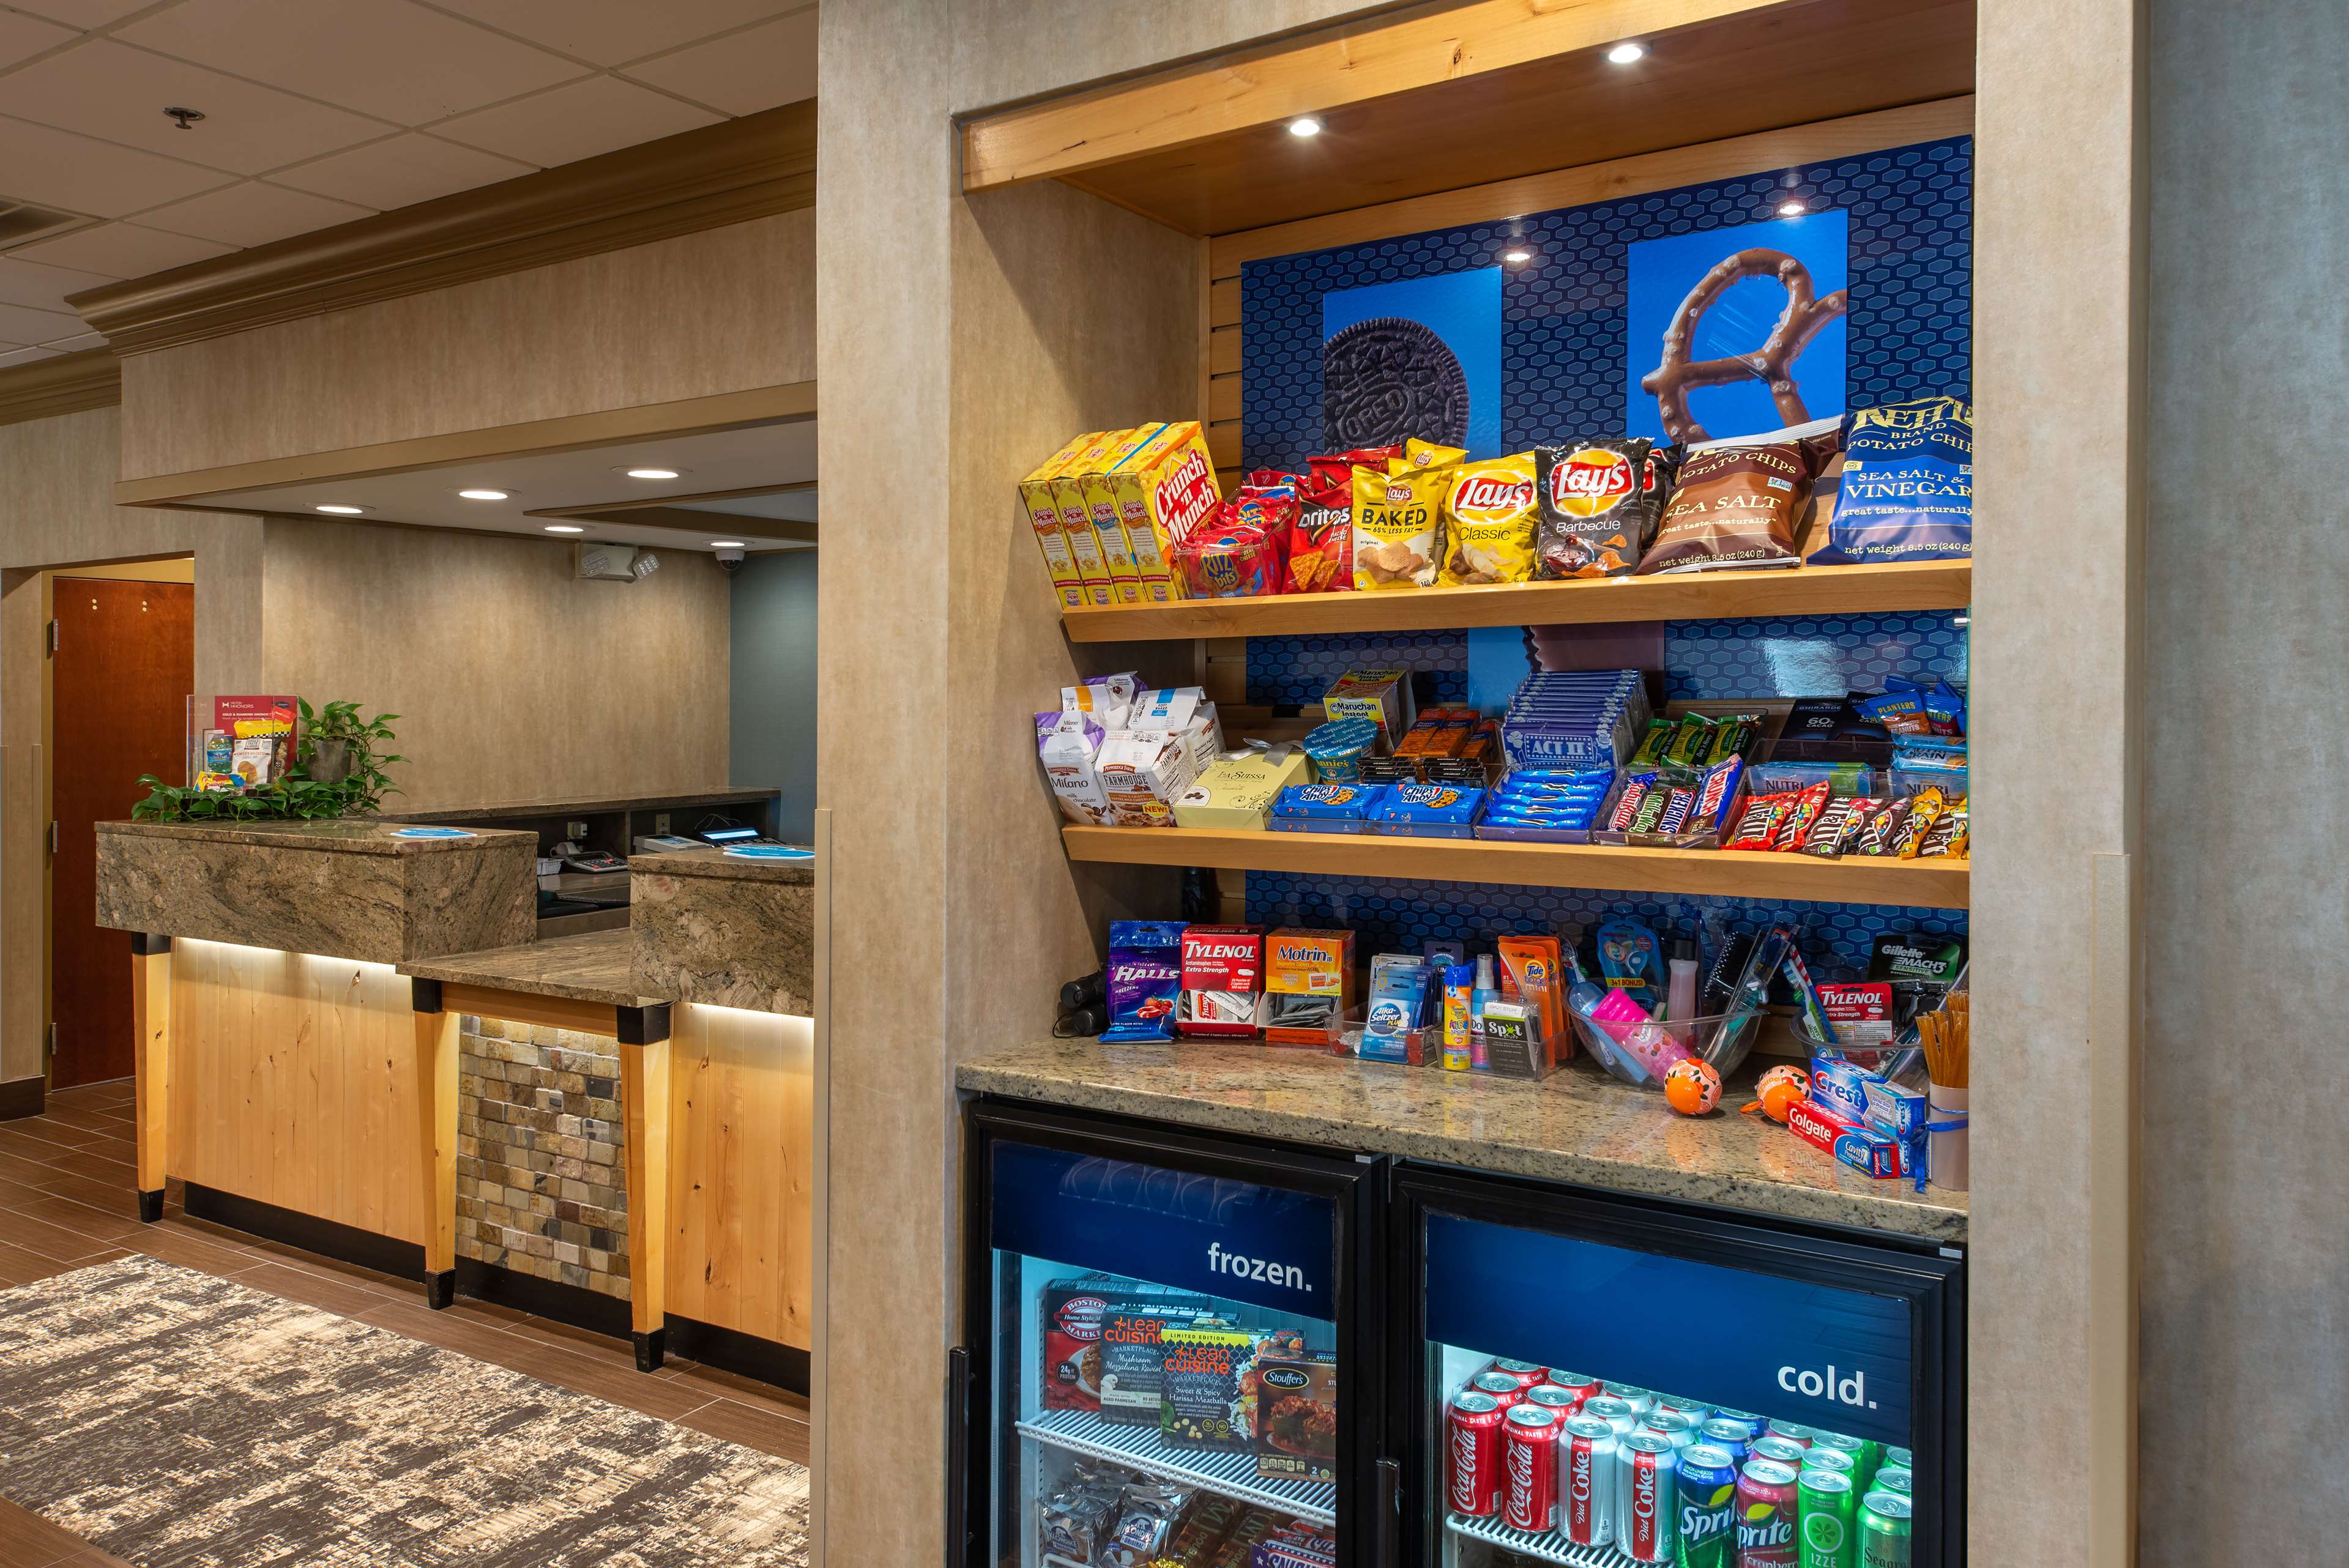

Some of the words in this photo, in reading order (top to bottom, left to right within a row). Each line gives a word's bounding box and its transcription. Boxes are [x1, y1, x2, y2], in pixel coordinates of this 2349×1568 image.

[1891, 422, 1948, 439] BRAND
[1847, 438, 1924, 451] POTATO
[1745, 453, 1796, 474] CHIPS
[1557, 463, 1628, 500] Lay's
[1858, 472, 1893, 482] SEA
[1898, 469, 1946, 483] SALT
[1156, 451, 1207, 523] Crunch
[1387, 485, 1412, 501] Lay's
[1846, 481, 1973, 499] VINEGAR
[1457, 478, 1532, 511] Lay's
[1063, 506, 1083, 518] Crunch
[1092, 503, 1112, 514] Crunch
[1122, 500, 1143, 512] Crunch
[1666, 502, 1707, 520] SEA
[1714, 495, 1782, 510] SALT
[1842, 507, 1872, 517] great
[1033, 508, 1054, 519] Crunch
[1096, 513, 1115, 522] Munch
[1126, 511, 1145, 520] Munch
[1169, 481, 1216, 547] Munch
[1361, 508, 1427, 527] BAKED
[1037, 519, 1057, 527] Munch
[1067, 516, 1086, 526] Munch
[1556, 519, 1620, 533] Barbecue
[1459, 526, 1511, 541] Classic
[1844, 546, 1863, 555] net
[1866, 544, 1905, 555] weight
[1938, 542, 1961, 552] (240
[1659, 558, 1675, 567] net
[1678, 555, 1711, 565] weight
[1737, 549, 1756, 561] (240
[1214, 571, 1237, 588] bits
[1338, 702, 1377, 711] Maruchan
[1877, 701, 1915, 715] PLANTERS
[1740, 727, 1748, 738] Honey
[1532, 740, 1565, 755] ACT
[1566, 741, 1586, 756] II
[1661, 744, 1670, 754] Oats
[1669, 734, 1677, 743] Honey
[1696, 748, 1705, 757] Oats
[1704, 734, 1713, 745] Honey
[1160, 743, 1180, 770] FARMHOUSE
[1051, 778, 1089, 789] Milano
[1103, 774, 1148, 786] FARMHOUSE
[1765, 779, 1804, 791] NUTRI
[1302, 785, 1332, 797] Chips
[1404, 786, 1434, 797] Chips
[1701, 771, 1728, 817] CRUNCH
[1185, 942, 1255, 959] TYLENOL
[1277, 945, 1328, 962] Motrin
[1881, 945, 1923, 959] Gillette
[1527, 965, 1544, 977] Tide
[1894, 965, 1929, 974] SENSITIVE
[1901, 957, 1947, 974] MACH3
[1114, 966, 1180, 981] HALLS
[1525, 983, 1547, 992] mini
[1821, 990, 1882, 1006] TYLENOL
[1371, 1013, 1400, 1022] Seltzer
[1450, 1020, 1469, 1030] KIDS
[1815, 1071, 1862, 1109] Crest
[1789, 1108, 1832, 1143] Colgate
[1845, 1141, 1865, 1157] Cavity
[1844, 1150, 1864, 1165] Protection
[1208, 1242, 1312, 1292] frozen.
[1113, 1345, 1157, 1356] MARKETPLACE
[1188, 1347, 1230, 1362] Lean
[1117, 1353, 1152, 1364] Mushroom
[1105, 1361, 1139, 1372] Mezzaluna
[1174, 1375, 1220, 1386] MARKETPLACE
[1268, 1372, 1304, 1385] Stouffer's
[1175, 1386, 1194, 1395] Sweet
[1203, 1388, 1221, 1397] Spicy
[1777, 1365, 1877, 1410] cold.
[1169, 1394, 1193, 1402] Harissa
[1194, 1395, 1227, 1405] Meatballs
[1505, 1424, 1524, 1436] ORIGINAL
[1571, 1451, 1590, 1501] Coke
[1634, 1467, 1654, 1518] Coke
[1575, 1501, 1586, 1525] Diet
[1639, 1518, 1649, 1543] Diet
[1124, 1537, 1144, 1550] ORIGINAL
[1811, 1553, 1837, 1567] IZZE
